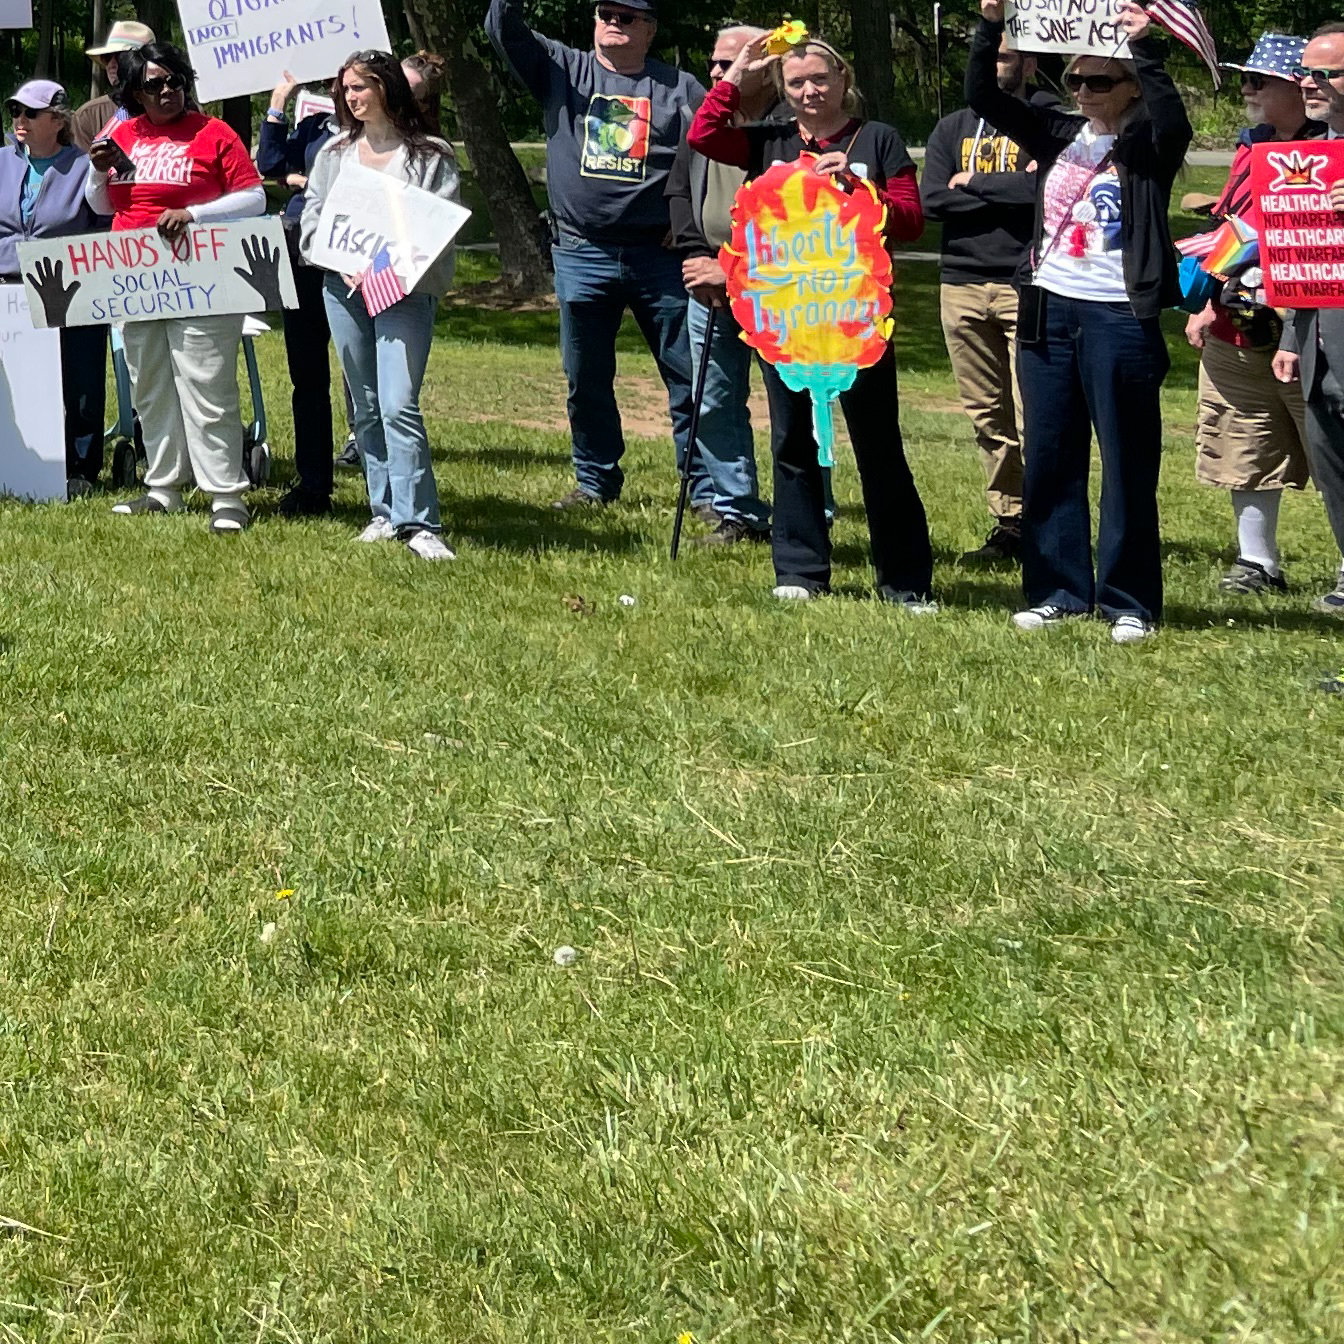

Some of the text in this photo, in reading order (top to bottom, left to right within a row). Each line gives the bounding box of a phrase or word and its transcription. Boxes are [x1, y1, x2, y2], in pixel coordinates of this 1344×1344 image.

[198, 23, 233, 44] NOT
[213, 5, 360, 68] IMMIGRANTS!
[1005, 13, 1121, 47] THE "SAVE" ACT
[130, 139, 190, 159] WE ARE
[585, 155, 641, 172] RESIST
[1264, 213, 1286, 229] NOT
[745, 210, 857, 285] Liberty
[1265, 228, 1344, 246] HEALTHCAR
[68, 228, 228, 275] HANDS OFF
[1268, 248, 1291, 263] NOT
[113, 268, 191, 296] SOCIAL
[1273, 282, 1298, 297] NOT
[92, 284, 216, 320] SECURITY
[741, 289, 880, 345] Tyranny
